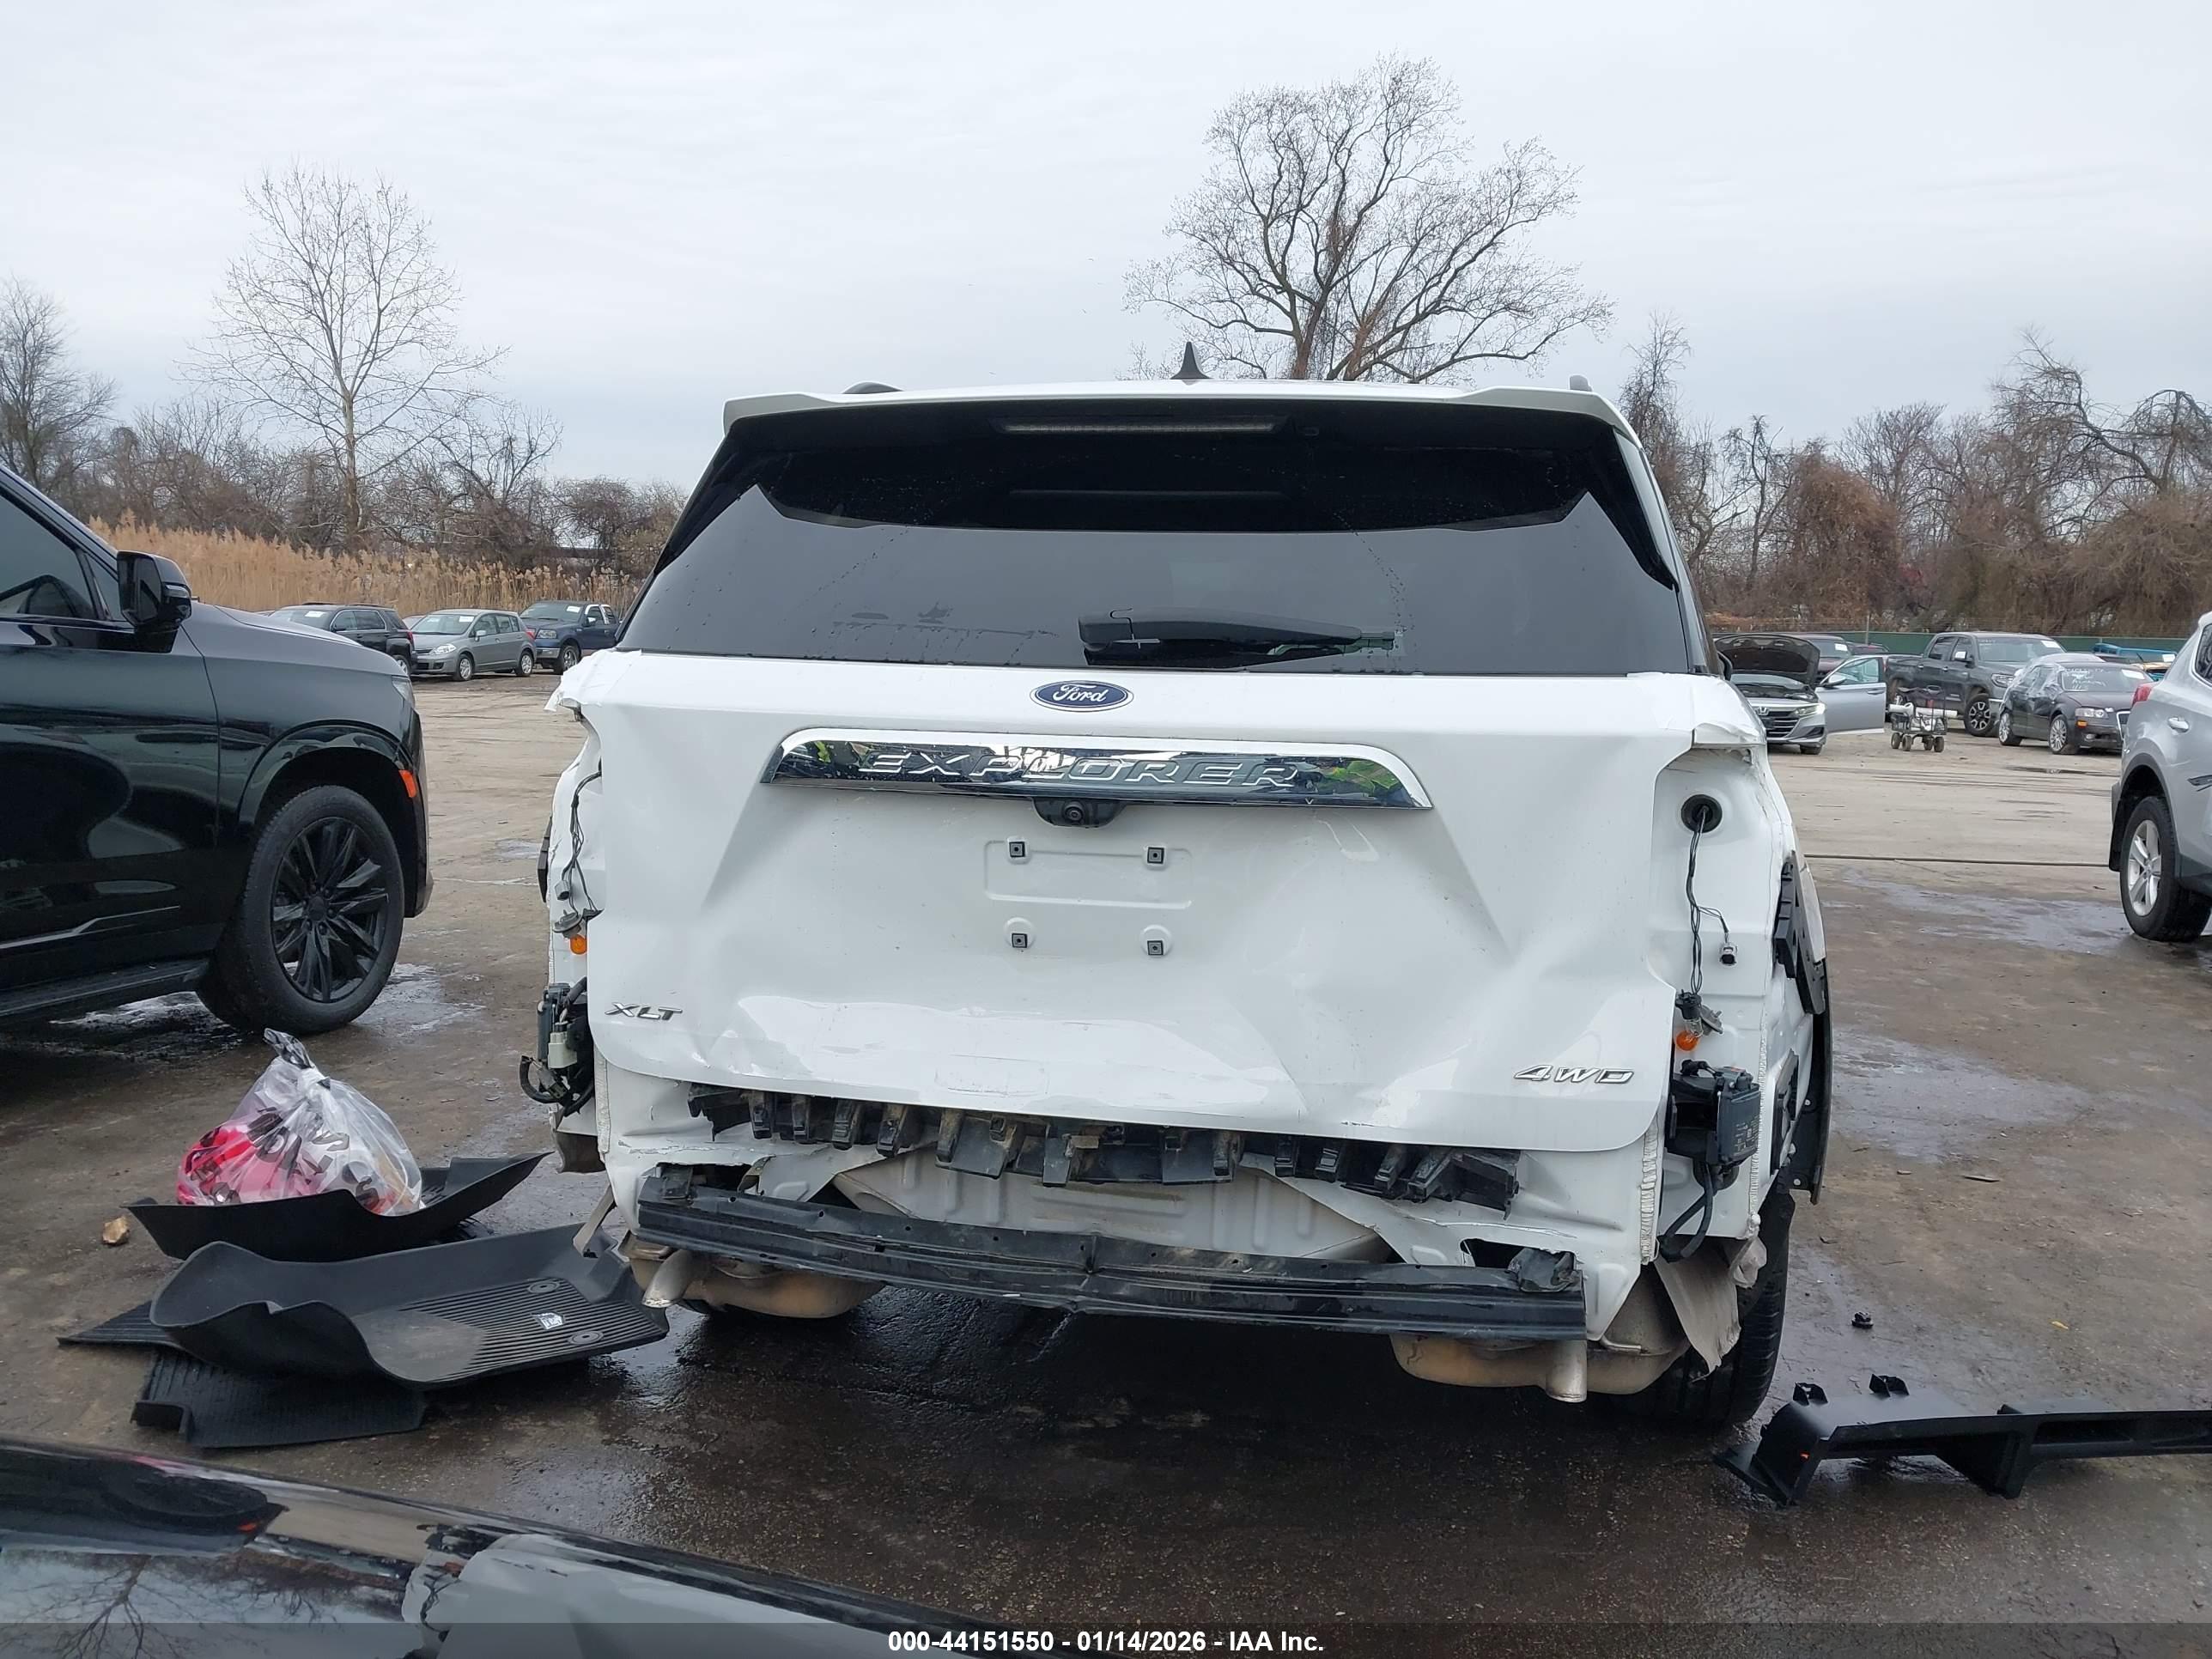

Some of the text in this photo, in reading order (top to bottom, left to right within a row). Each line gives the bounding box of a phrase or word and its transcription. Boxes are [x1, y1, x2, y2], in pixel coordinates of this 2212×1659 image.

[1052, 684, 1109, 702] Ford
[857, 752, 1298, 787] EXPLORER
[604, 1001, 684, 1021] XLT
[1514, 1065, 1634, 1084] 4WD
